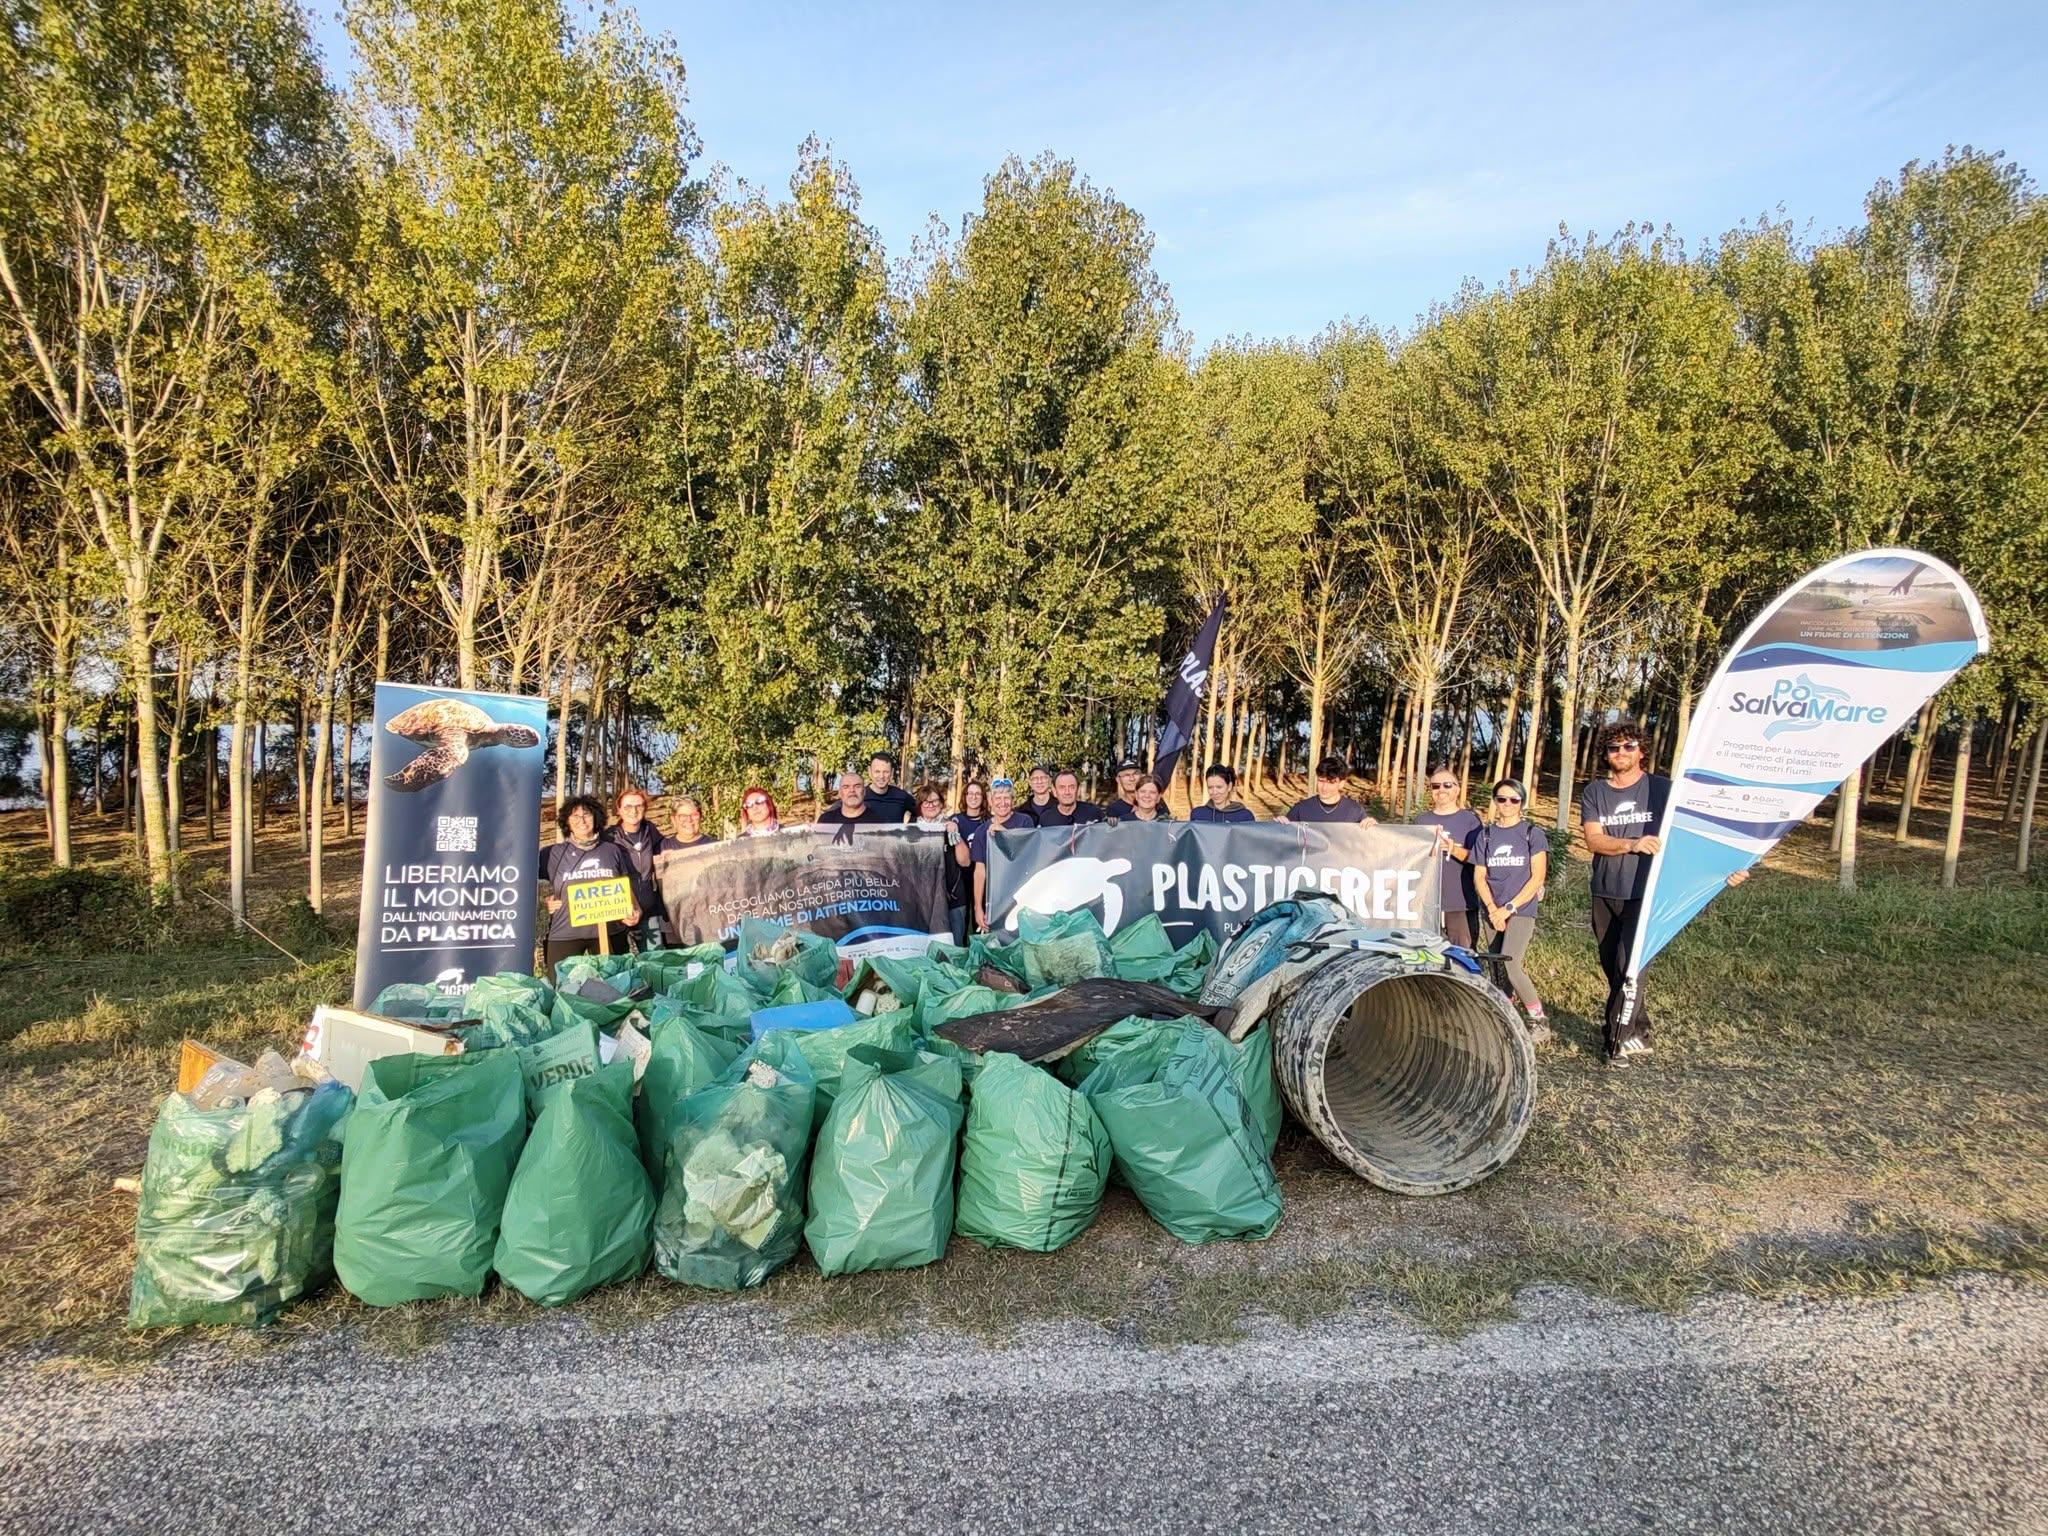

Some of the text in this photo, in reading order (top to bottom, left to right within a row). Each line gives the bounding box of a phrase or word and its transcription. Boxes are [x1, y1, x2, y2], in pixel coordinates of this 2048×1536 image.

[1773, 679, 1811, 701] Po
[1729, 692, 1888, 724] SalvaMare
[1723, 740, 1841, 760] Progetto per la riduzione
[1731, 752, 1774, 764] recupero
[1774, 756, 1785, 765] di
[1786, 757, 1821, 768] plastic
[1820, 760, 1844, 770] litter
[1740, 762, 1813, 777] nei nostri fiumi
[1599, 811, 1654, 827] PLASTICFREE
[385, 864, 520, 884] LIBERIAMO
[383, 886, 519, 908] IL MONDO
[573, 882, 626, 902] AREA
[708, 888, 795, 916] RACCOGLIAMO
[796, 886, 812, 897] LA
[811, 879, 842, 894] SFIDA
[573, 896, 628, 911] PULITA DA
[762, 905, 778, 917] AL
[778, 895, 824, 913] NOSTRO
[824, 888, 889, 903] TERRITORIO
[382, 909, 518, 924] DALL'INQUINAMENTO
[796, 909, 813, 924] DI
[380, 923, 517, 944] DA PLASTICA
[529, 1053, 594, 1092] VERDE
